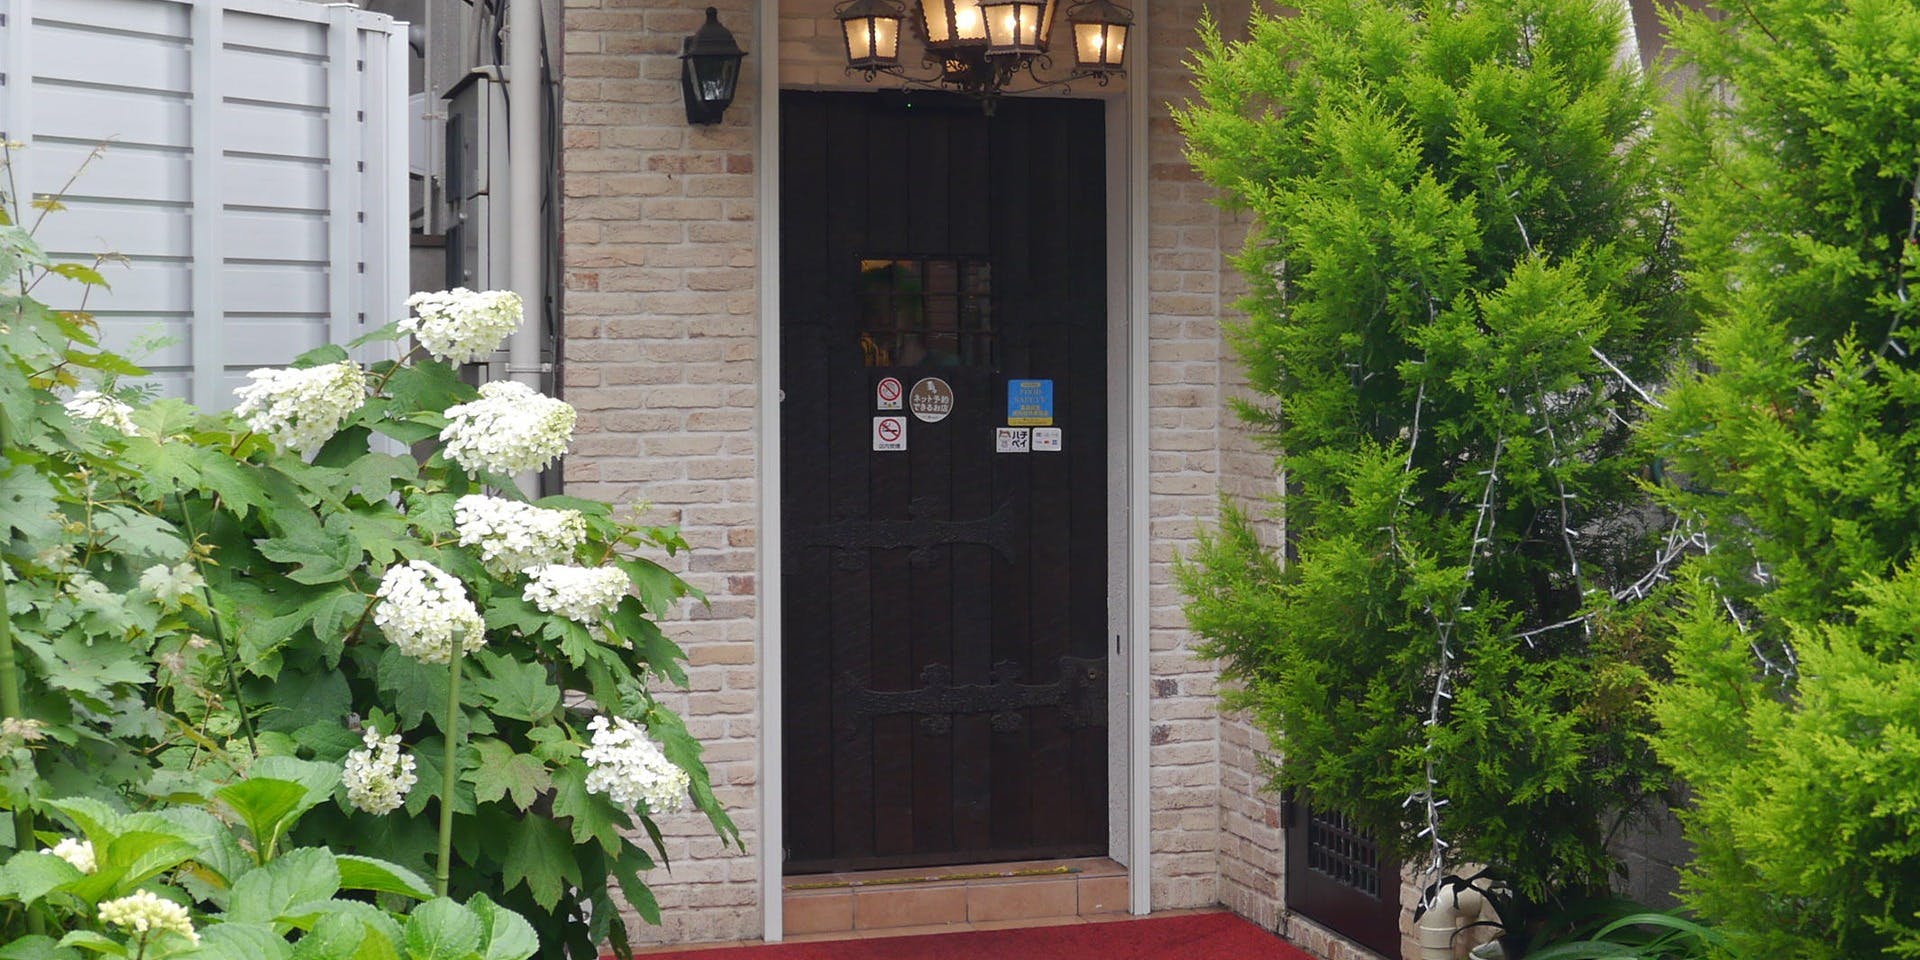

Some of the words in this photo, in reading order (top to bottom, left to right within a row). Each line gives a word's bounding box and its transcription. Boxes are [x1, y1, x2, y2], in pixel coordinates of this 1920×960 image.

[913, 394, 949, 404] ネット予約
[913, 404, 949, 412] できるお店
[1012, 431, 1028, 440] ハチ
